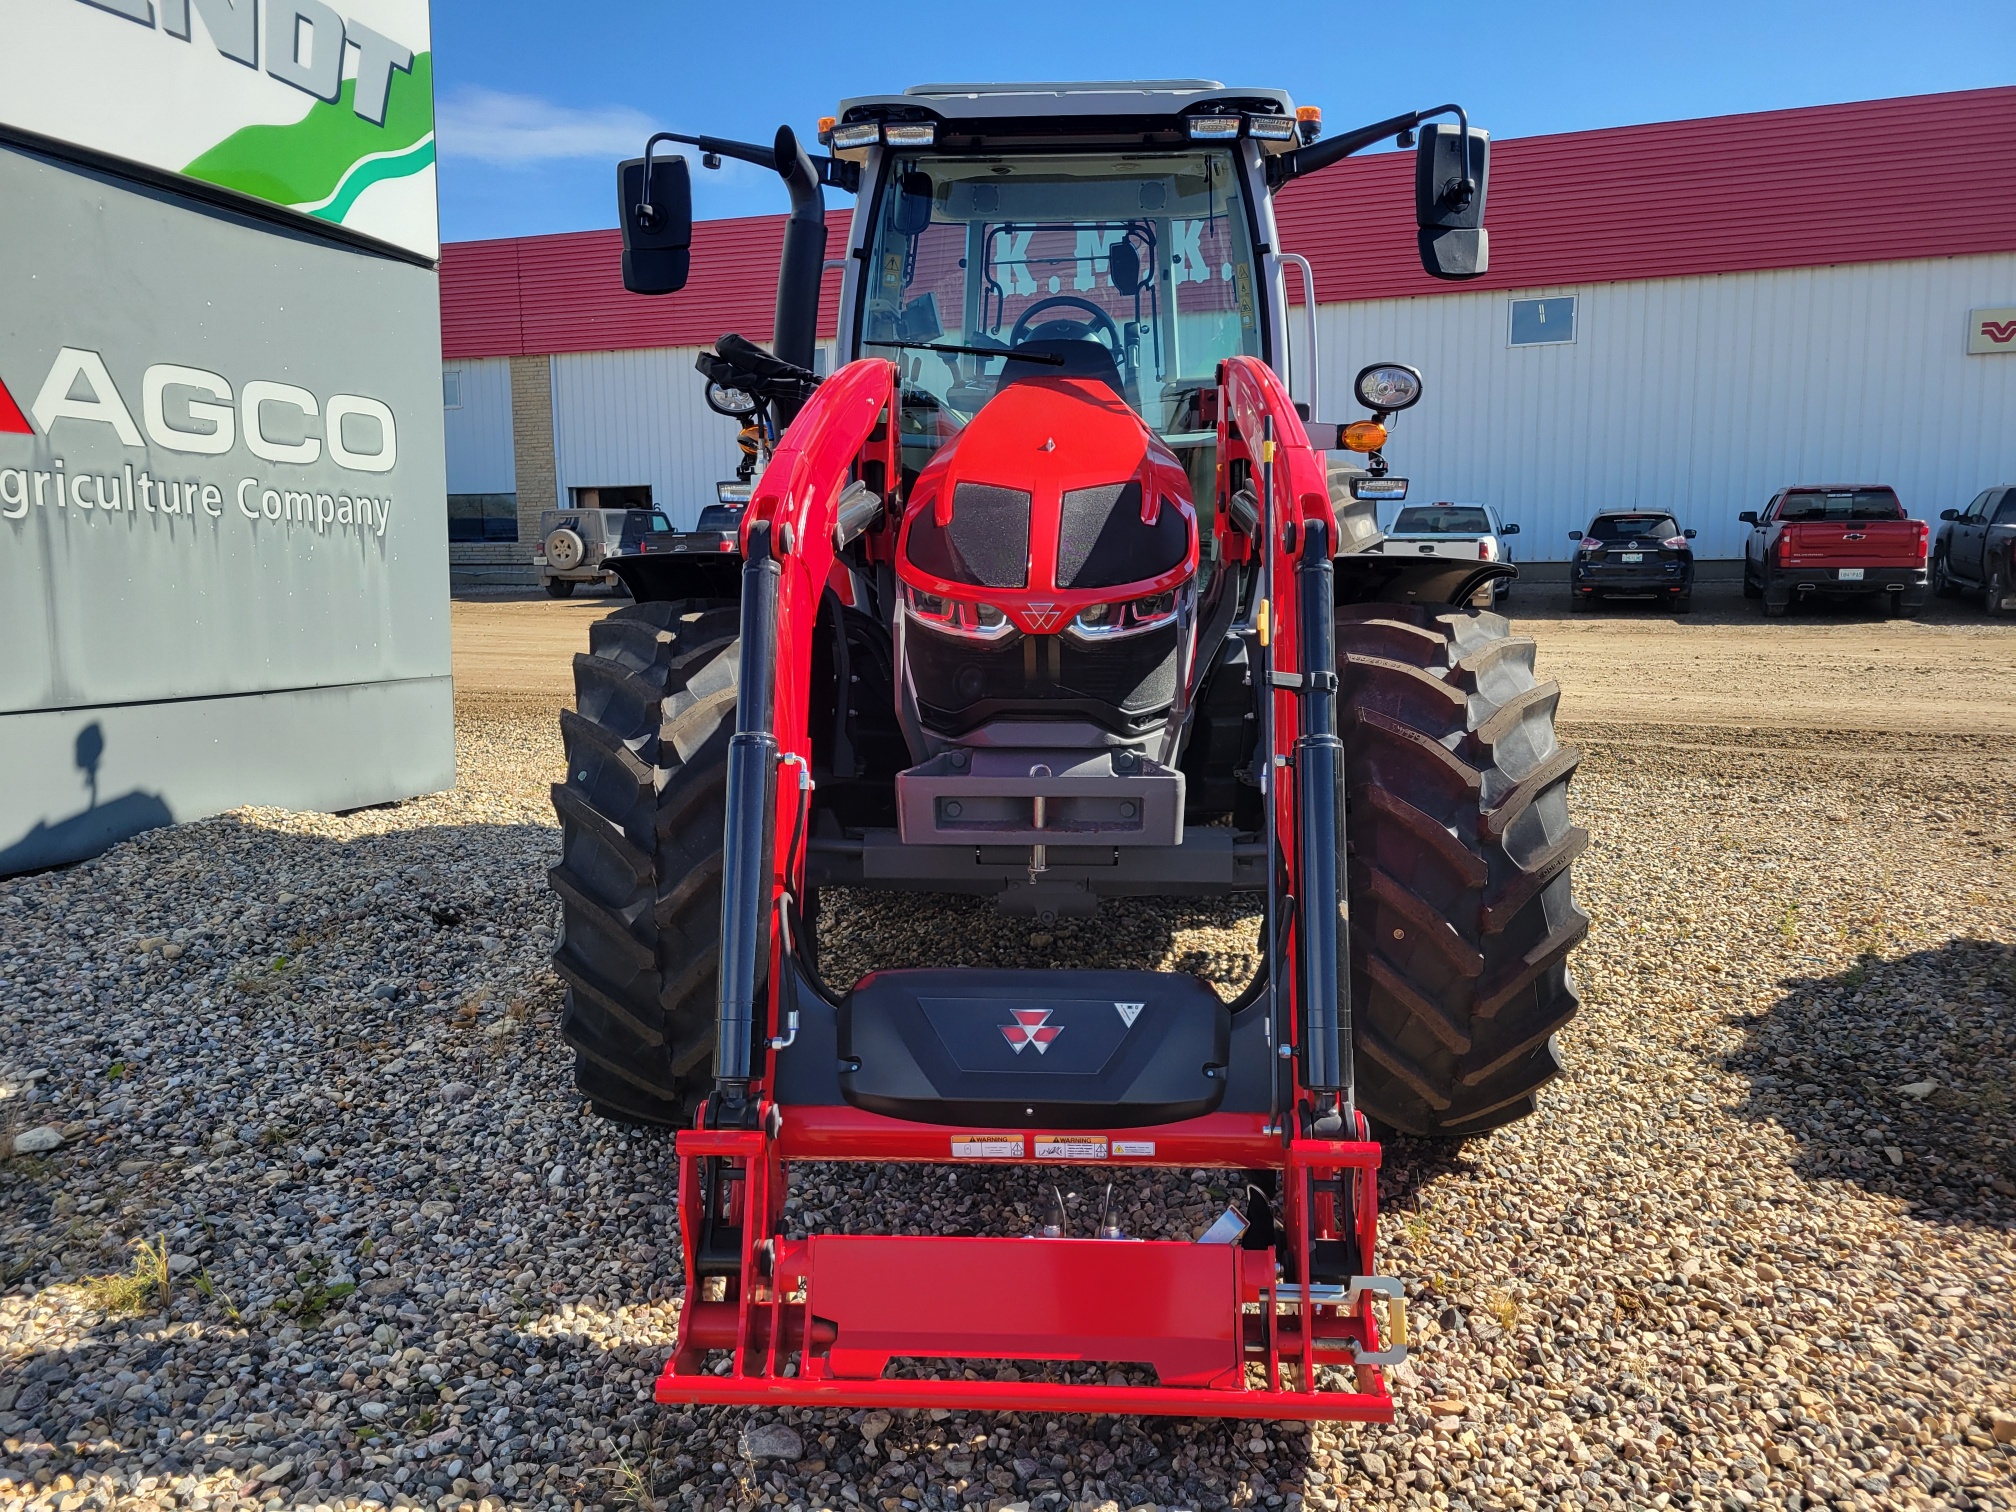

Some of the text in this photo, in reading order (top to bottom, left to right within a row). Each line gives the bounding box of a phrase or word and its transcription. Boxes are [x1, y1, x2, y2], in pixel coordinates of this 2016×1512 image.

[75, 0, 414, 128] NDT
[31, 346, 397, 472] AGCO
[0, 458, 391, 536] griculture Company
